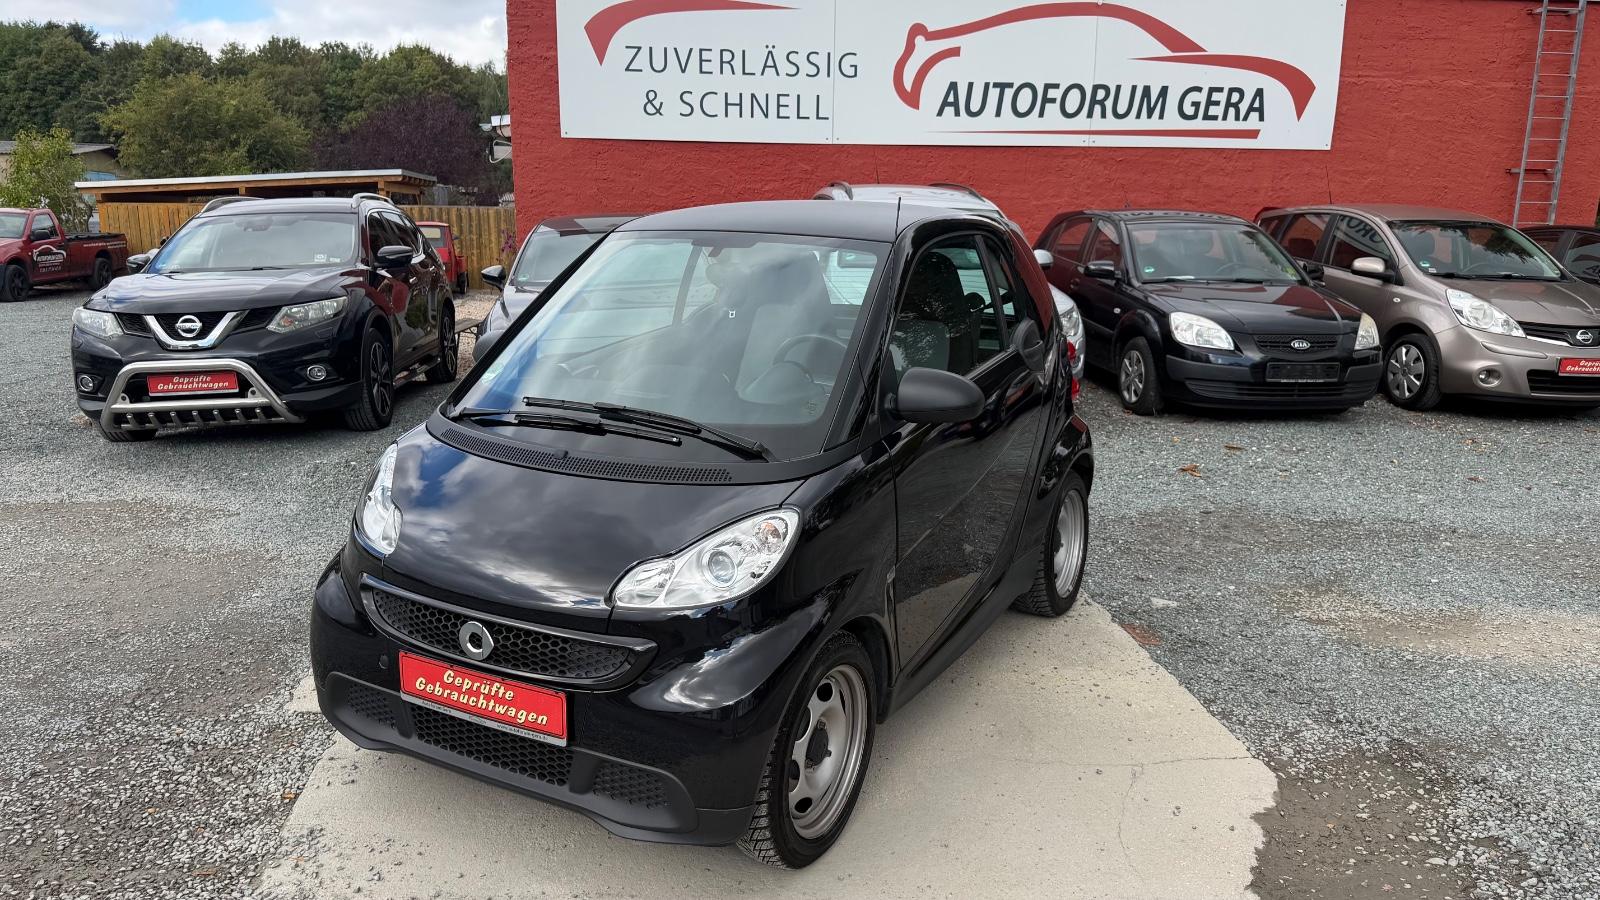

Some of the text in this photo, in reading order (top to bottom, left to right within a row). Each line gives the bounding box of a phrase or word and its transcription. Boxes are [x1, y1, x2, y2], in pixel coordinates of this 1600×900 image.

[624, 44, 859, 79] ZUVERLÄSSIG
[642, 89, 830, 121] & SCHNELL
[936, 81, 1265, 122] AUTOFORUM GERA
[157, 381, 229, 390] Gebrauchtwagen
[173, 375, 212, 384] Geprüfte
[415, 677, 548, 725] Gebrauchtwagen
[443, 670, 515, 700] Geprüfte
